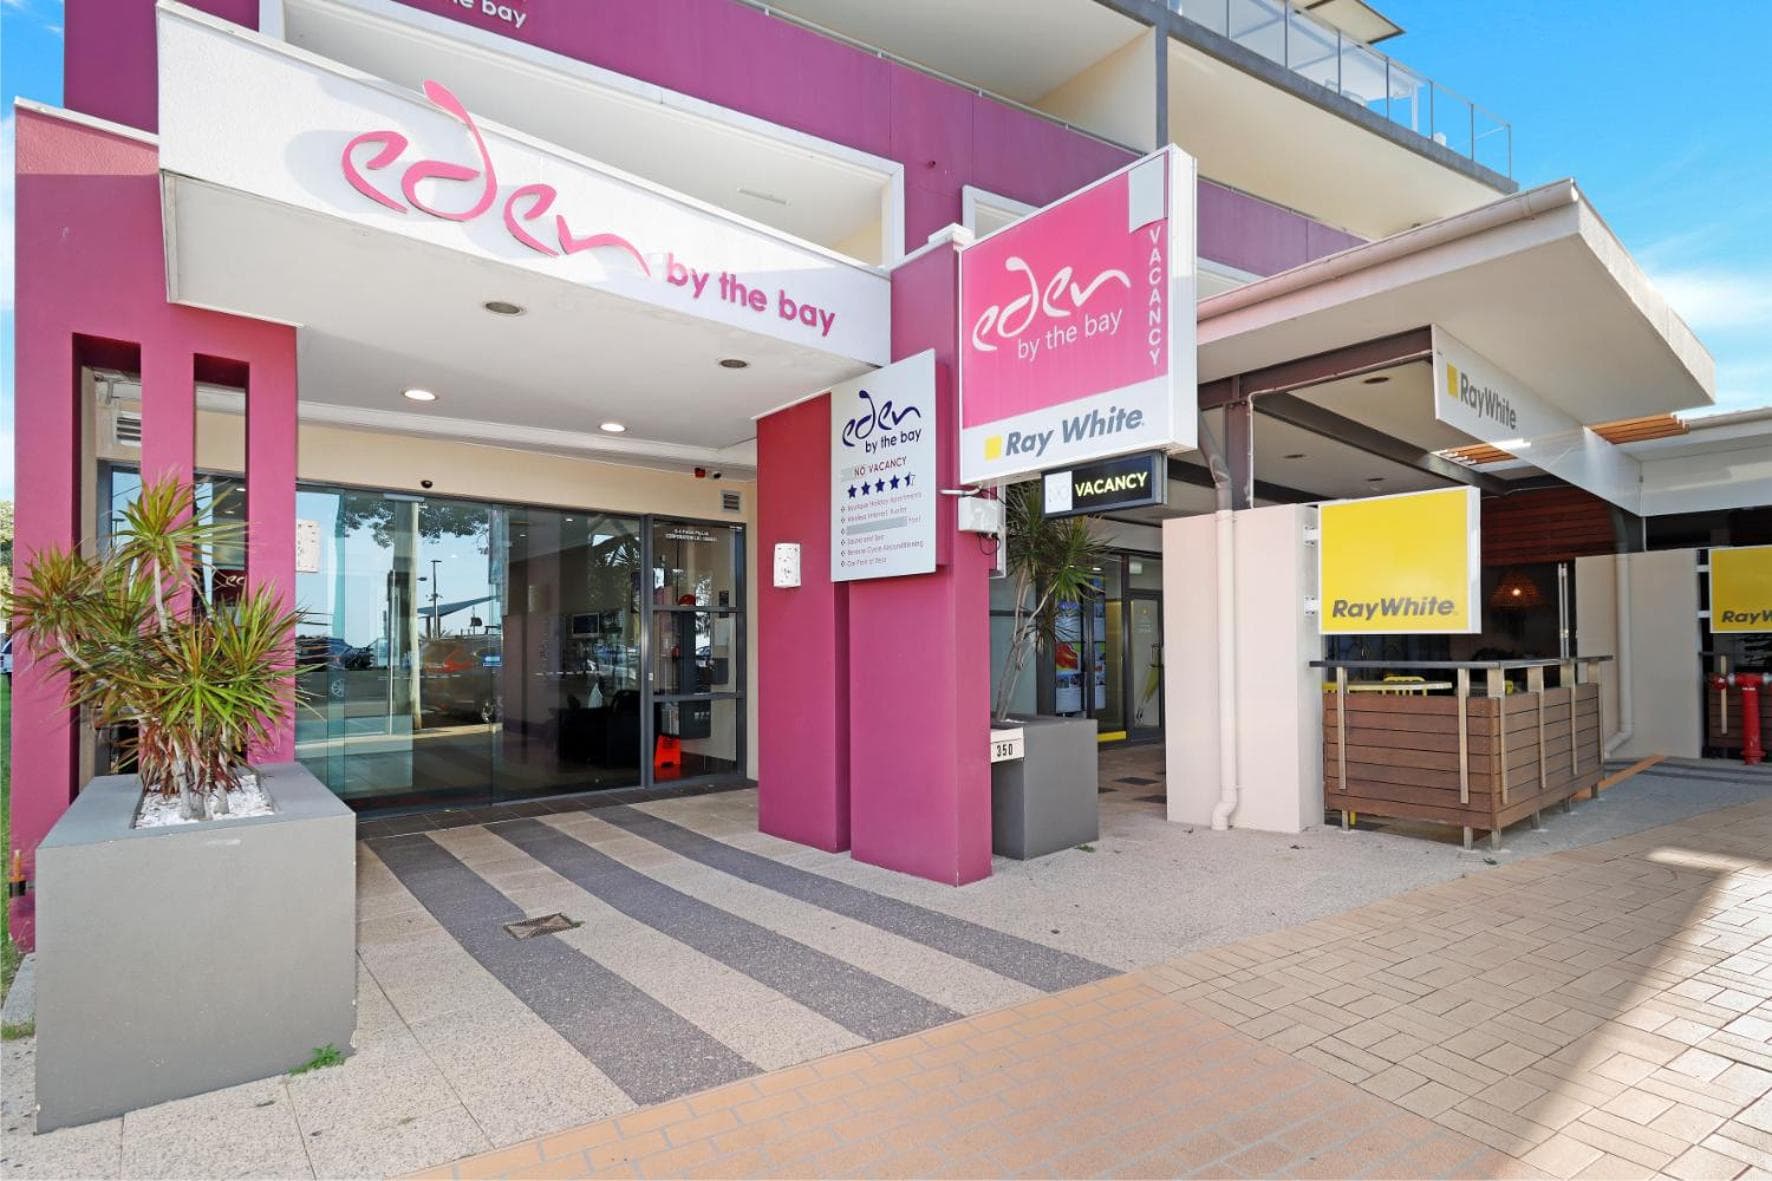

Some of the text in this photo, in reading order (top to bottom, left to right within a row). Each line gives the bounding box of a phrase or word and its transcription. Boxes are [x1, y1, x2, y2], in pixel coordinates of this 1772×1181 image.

[482, 0, 526, 28] bay
[341, 79, 651, 277] eden
[667, 252, 836, 337] by the bay
[972, 256, 1131, 351] eden
[1148, 226, 1161, 366] VACANCY
[1017, 308, 1122, 362] by the bay
[842, 390, 921, 447] eden
[1460, 372, 1517, 430] RayWhite
[865, 428, 921, 454] by the bay
[1005, 406, 1144, 457] Ray White
[854, 456, 907, 477] NO VACANCY
[1074, 471, 1148, 497] VACANCY
[1332, 596, 1455, 621] RayWhite
[996, 743, 1013, 757] 350
